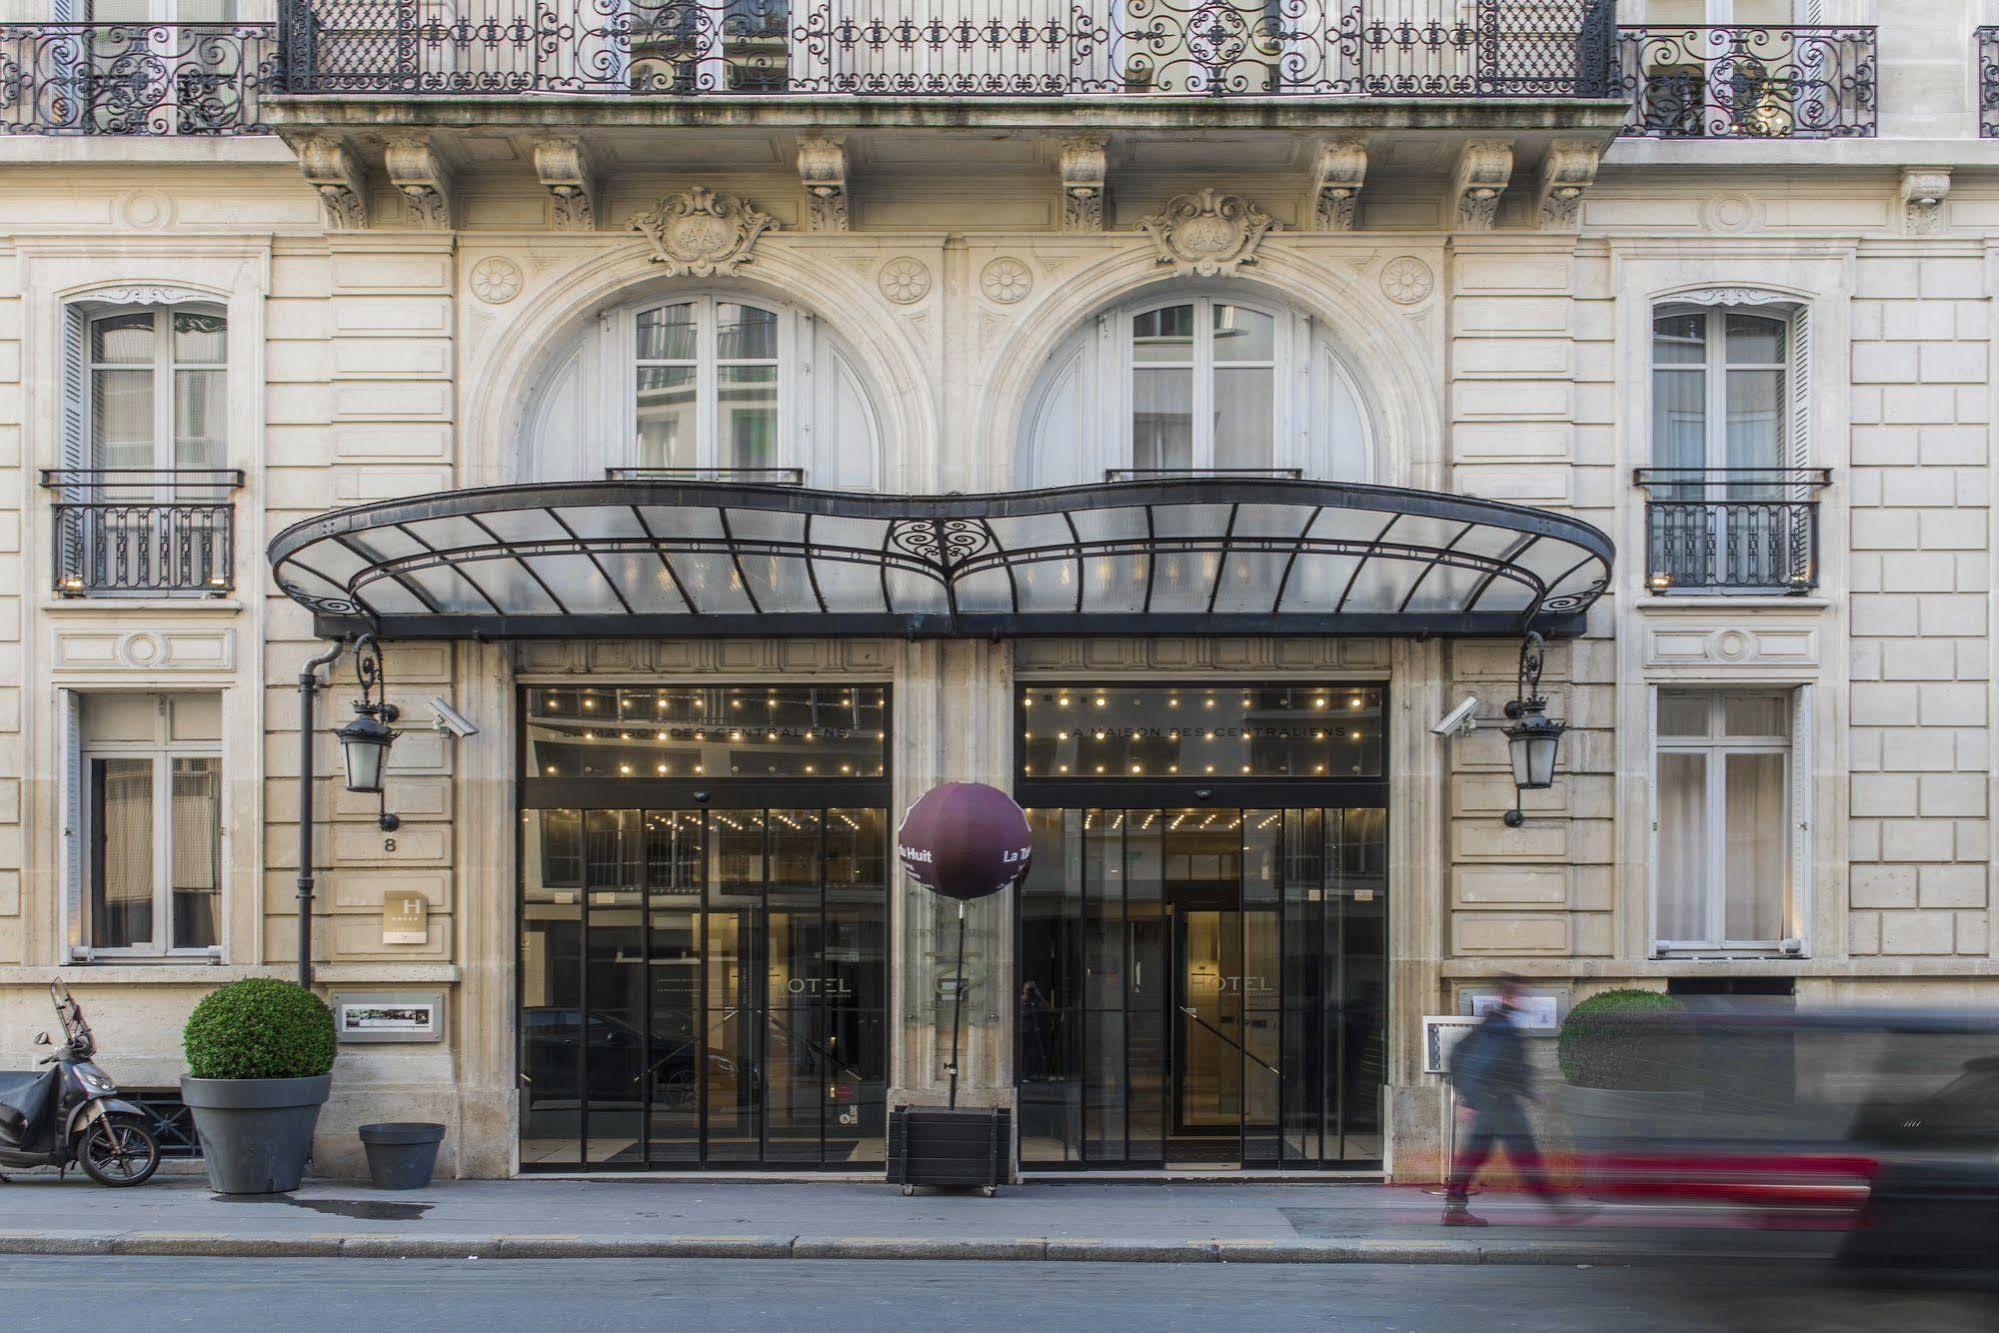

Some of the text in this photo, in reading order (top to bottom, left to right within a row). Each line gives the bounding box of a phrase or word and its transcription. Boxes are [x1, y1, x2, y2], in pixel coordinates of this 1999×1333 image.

[671, 727, 705, 738] DES
[1169, 727, 1205, 737] DES
[1214, 727, 1346, 737] CENTRALIENS
[384, 838, 397, 852] 8
[906, 847, 933, 863] Huit
[1002, 850, 1019, 863] La
[403, 899, 420, 913] H
[1191, 976, 1273, 991] HOTEL
